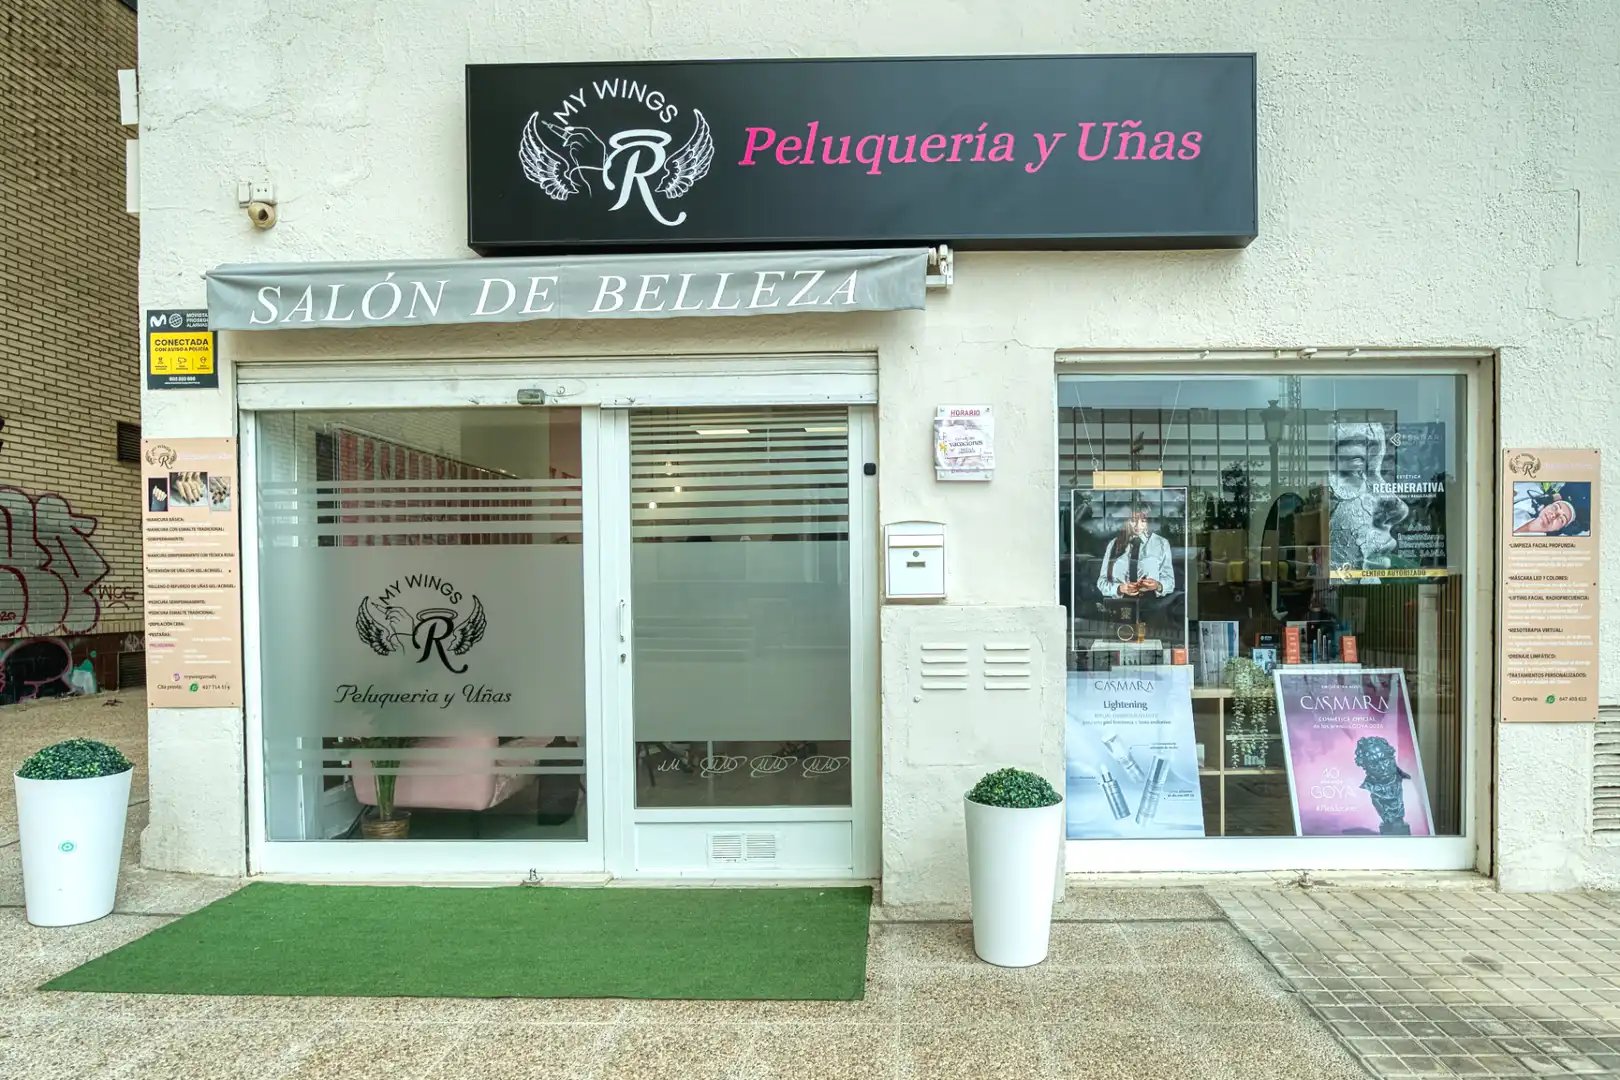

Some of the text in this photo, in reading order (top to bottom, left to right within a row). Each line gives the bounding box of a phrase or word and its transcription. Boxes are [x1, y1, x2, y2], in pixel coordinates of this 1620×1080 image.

[553, 78, 678, 125] MY WINGS
[737, 120, 1203, 175] Peluquería y Uñas
[603, 139, 687, 226] R
[250, 270, 859, 324] SALÓN DE BELLEZA
[154, 338, 209, 346] CONECTADA
[1372, 482, 1445, 493] REGENERATIVA
[1387, 569, 1426, 577] AUTORIZADO
[379, 574, 463, 605] MY WINGS
[412, 616, 468, 674] R
[440, 692, 456, 709] y
[462, 684, 512, 703] Uñas
[1094, 680, 1154, 692] CASMARA
[1103, 700, 1148, 710] Lightening
[1300, 695, 1389, 714] CASMARA
[1311, 786, 1357, 799] GOYA
